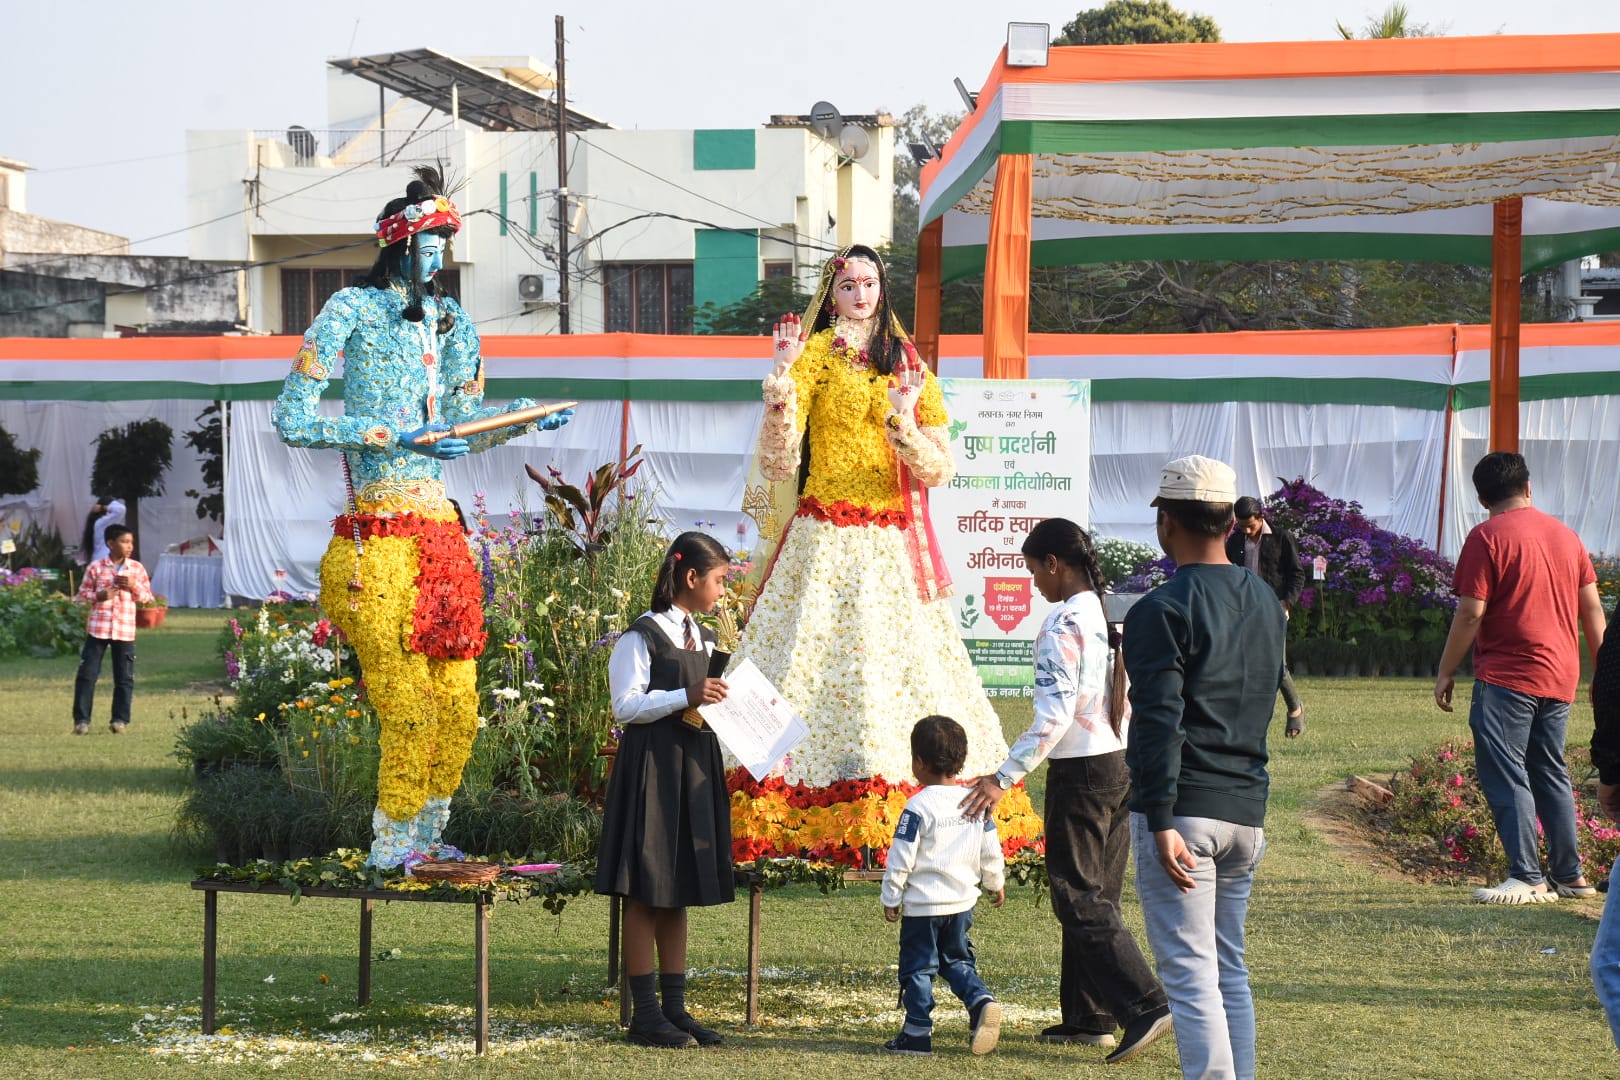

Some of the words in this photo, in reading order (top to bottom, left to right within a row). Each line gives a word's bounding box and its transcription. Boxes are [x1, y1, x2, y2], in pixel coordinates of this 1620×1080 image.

[978, 410, 1004, 419] लखनऊ
[1006, 410, 1022, 419] नगर
[1023, 409, 1043, 419] निगम
[963, 435, 994, 460] पुष्प
[999, 430, 1057, 454] प्रदर्शनी
[1004, 459, 1015, 469] एवं
[1004, 471, 1072, 491] प्रतियोगिता
[992, 497, 1000, 509] में
[1001, 499, 1027, 510] आपका
[957, 510, 1005, 533] हार्दिक
[1009, 516, 1048, 534] स्वा
[1003, 536, 1014, 546] एवं
[1000, 688, 1022, 698] नगर
[1022, 685, 1034, 698] नि
